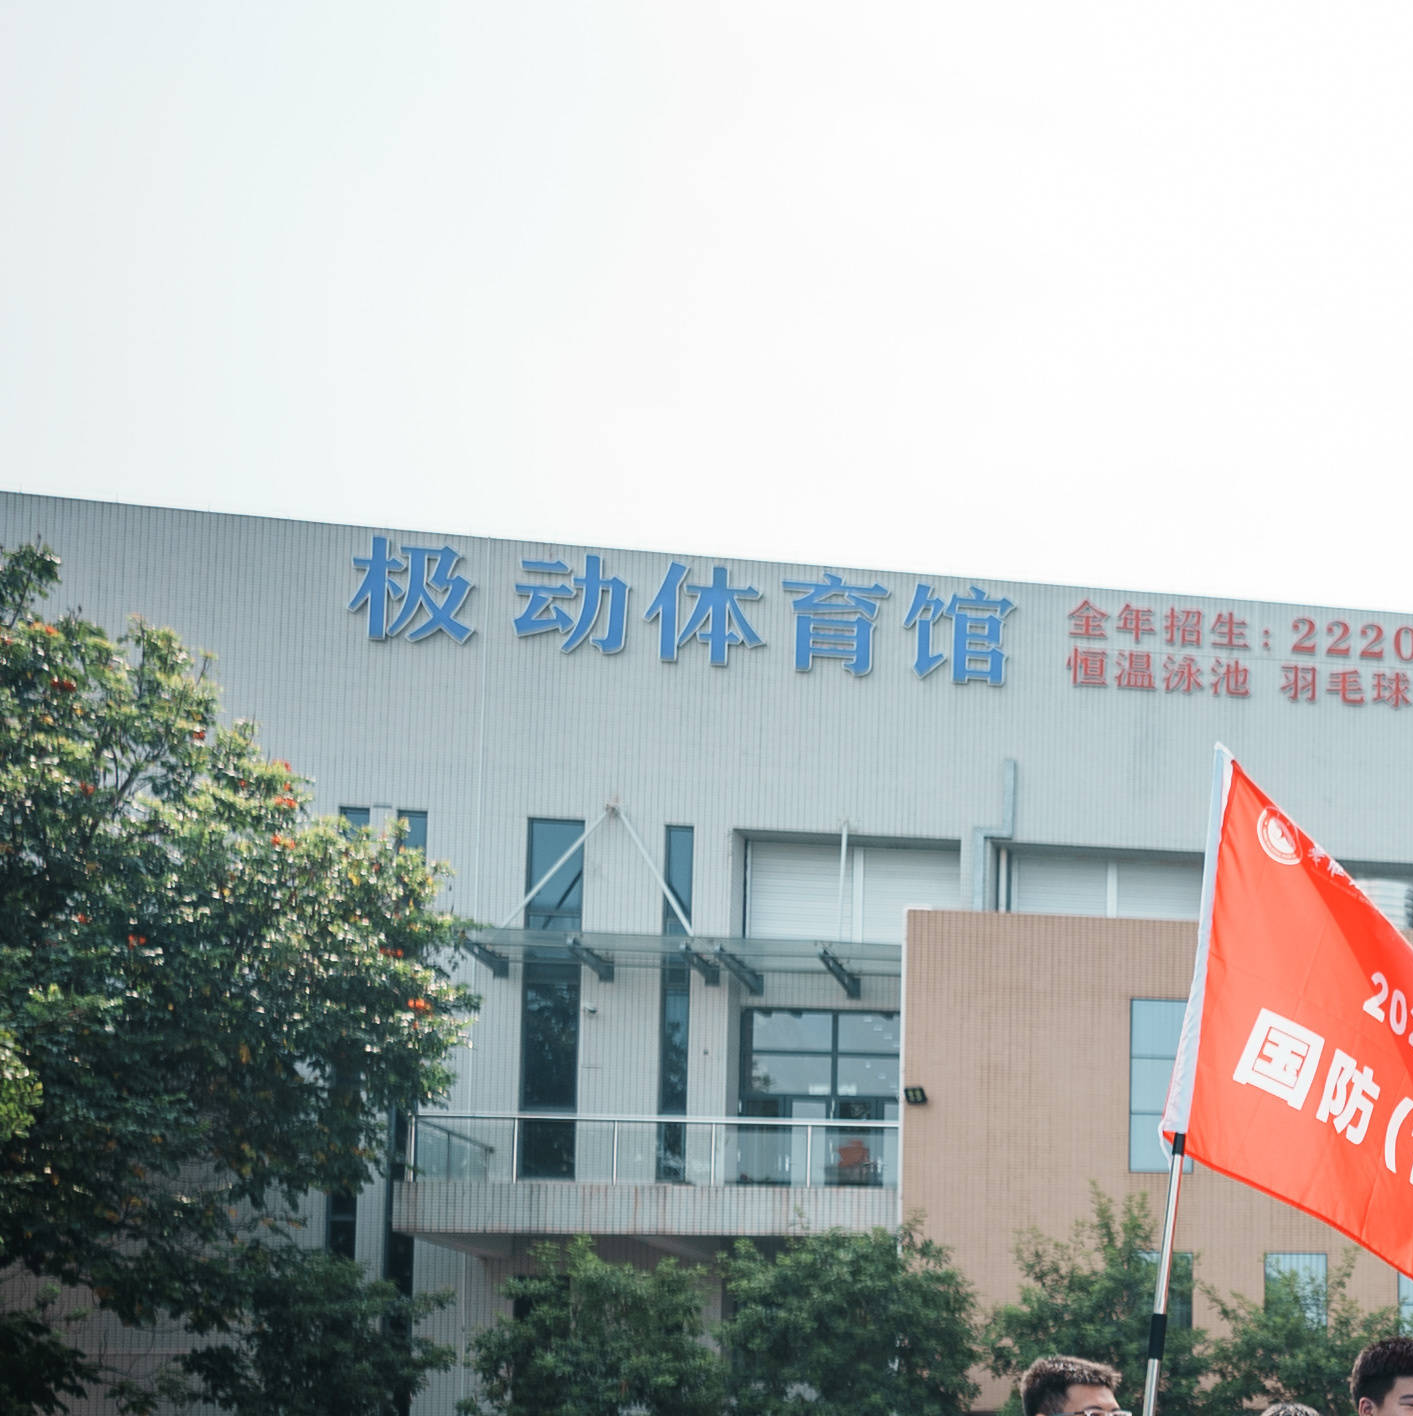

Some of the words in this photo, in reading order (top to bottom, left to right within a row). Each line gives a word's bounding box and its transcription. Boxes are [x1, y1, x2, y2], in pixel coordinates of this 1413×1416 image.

[347, 535, 1017, 687] 极动体育馆
[1066, 645, 1251, 698] 恒温泳池
[1280, 664, 1413, 709] 羽毛球
